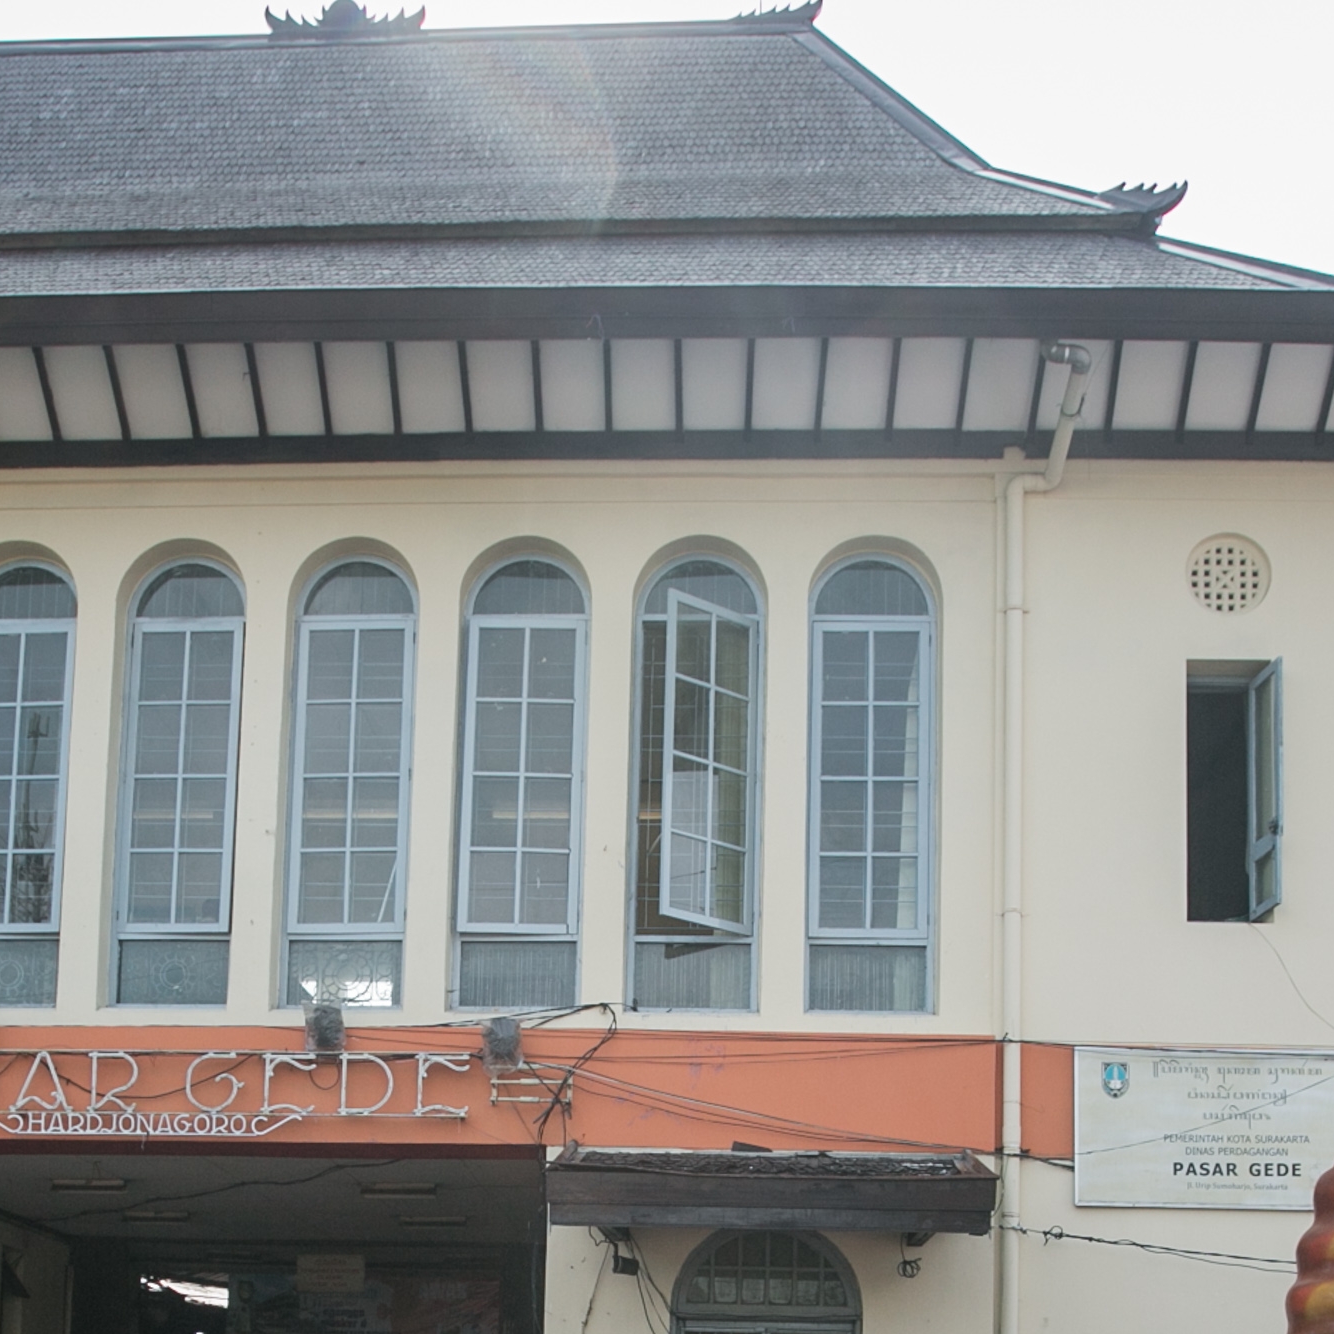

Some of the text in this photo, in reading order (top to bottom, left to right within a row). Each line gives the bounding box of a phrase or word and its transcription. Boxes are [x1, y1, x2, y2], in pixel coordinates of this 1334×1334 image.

[185, 1052, 471, 1115] GEDE
[28, 1111, 247, 1134] HARDJONAGORO
[1164, 1133, 1310, 1145] PEMERINTAH KOTA SURAKARTA
[1185, 1146, 1288, 1157] DINAS PERDAGANGAN
[1173, 1162, 1302, 1178] PASAR GEDE
